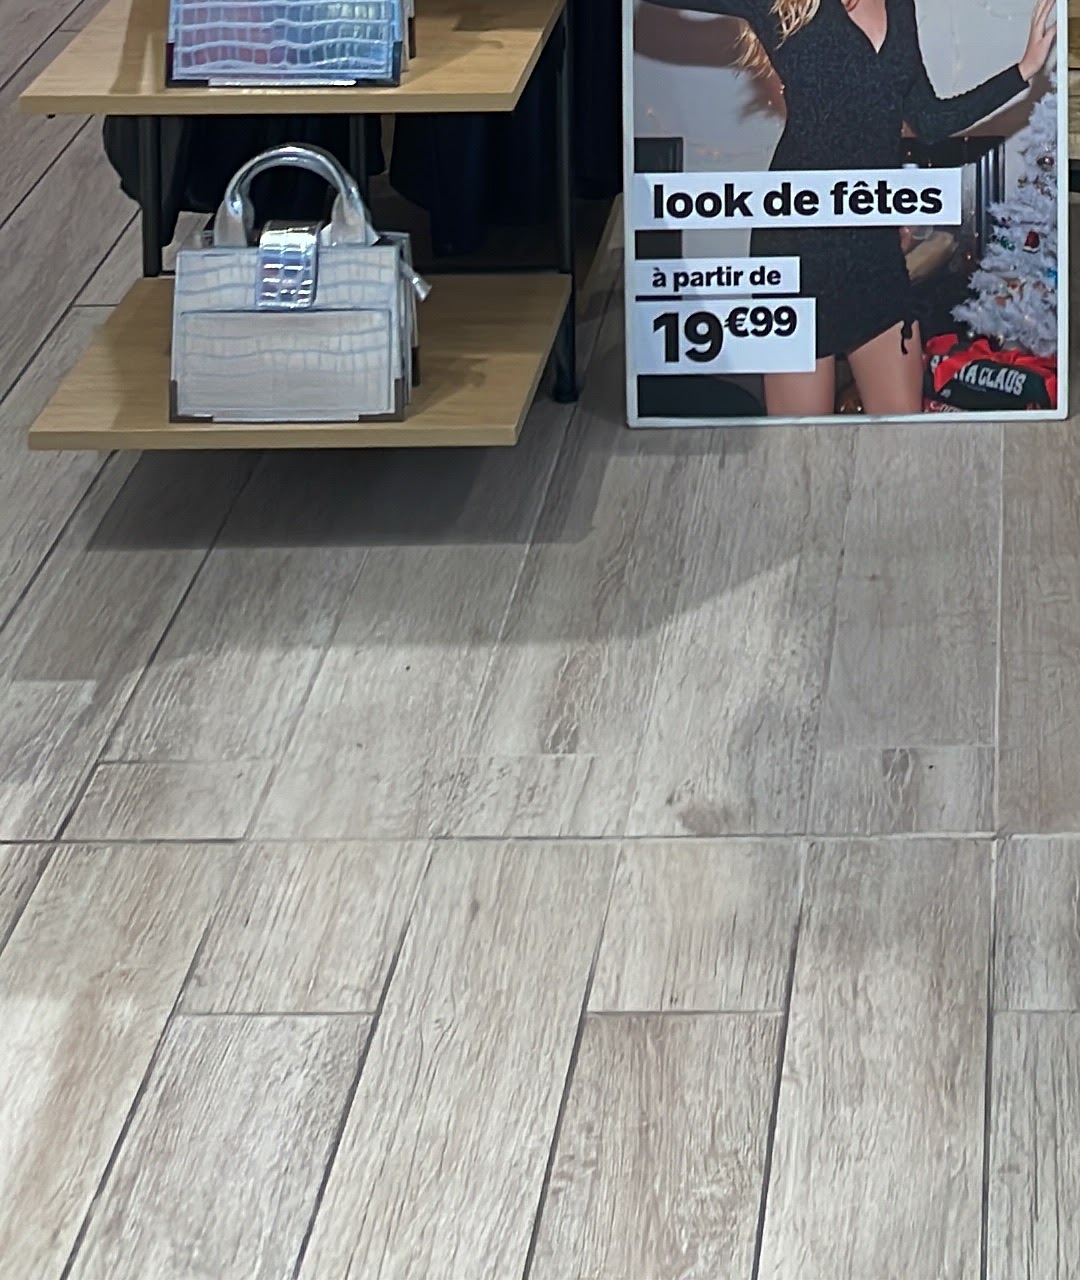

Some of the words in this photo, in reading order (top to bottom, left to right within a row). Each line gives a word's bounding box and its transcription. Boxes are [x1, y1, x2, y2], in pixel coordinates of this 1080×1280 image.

[653, 182, 754, 220] look
[763, 182, 820, 217] de
[830, 180, 943, 216] fêtes
[652, 266, 667, 288] à
[673, 266, 744, 293] partir
[749, 266, 782, 286] de
[978, 366, 1027, 396] CLAUS
